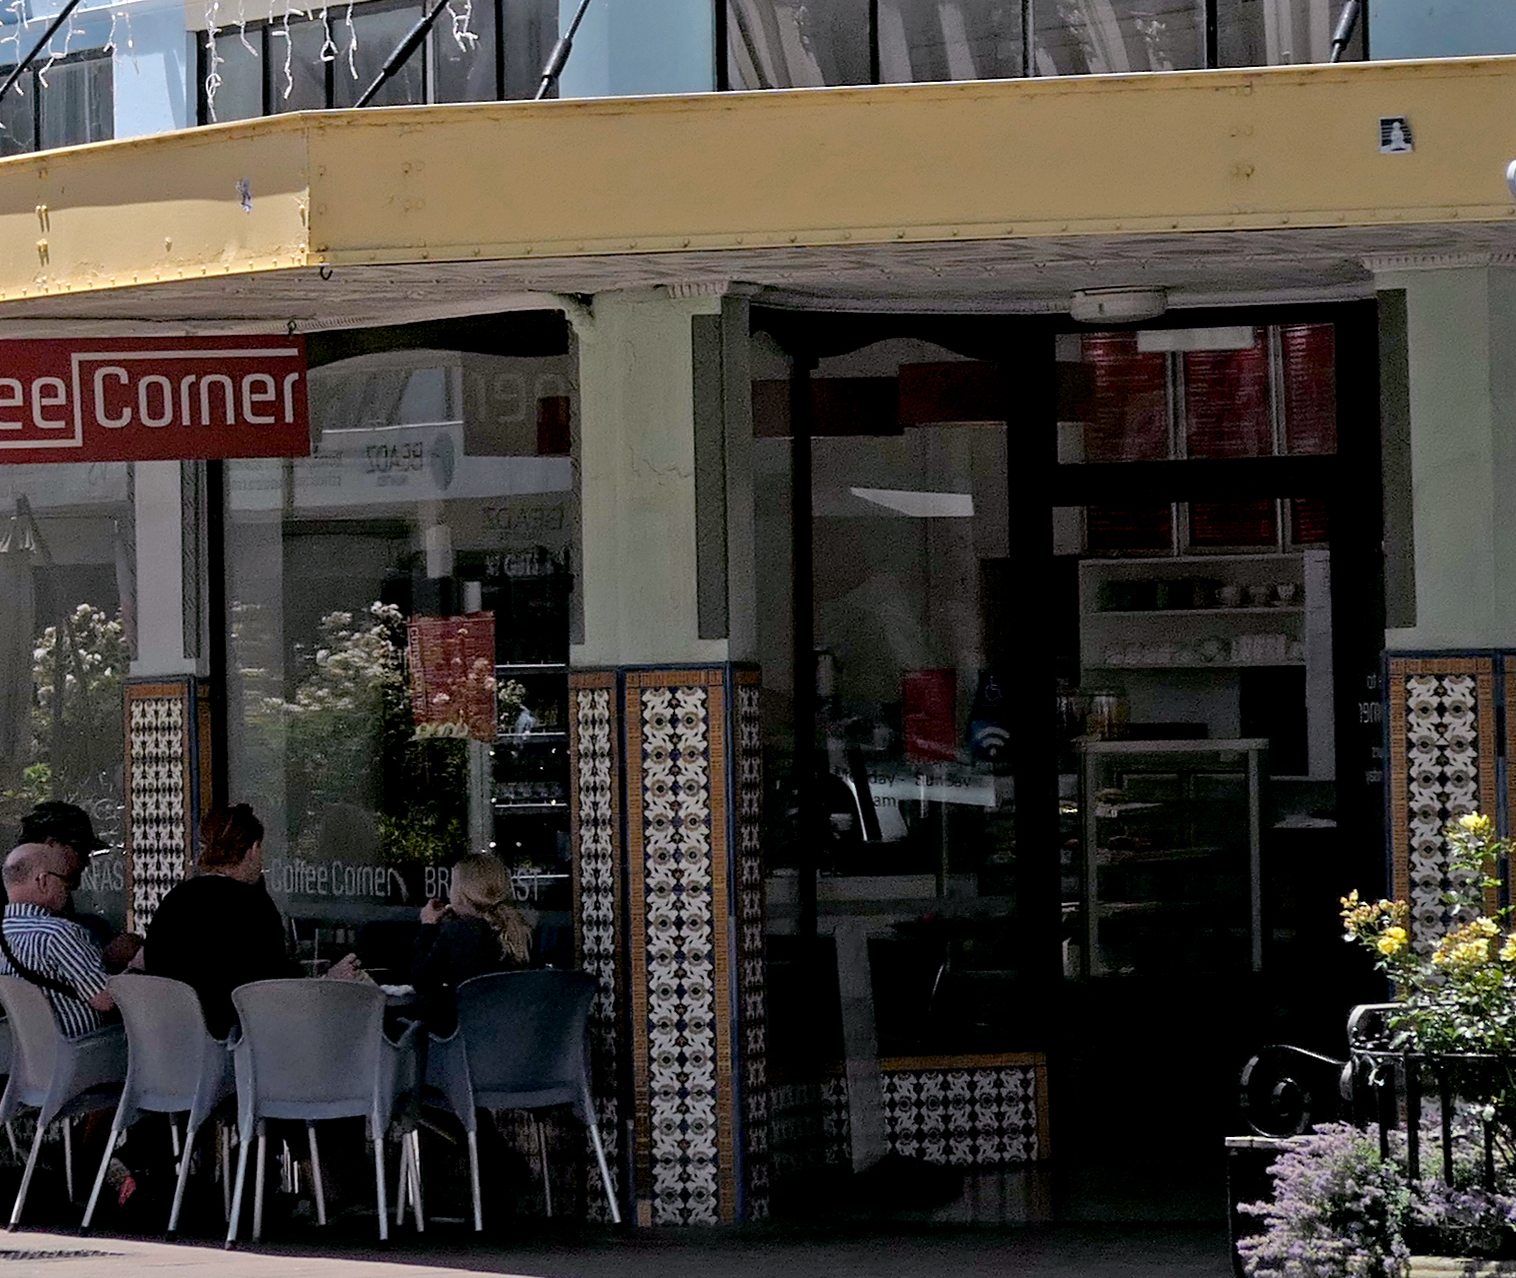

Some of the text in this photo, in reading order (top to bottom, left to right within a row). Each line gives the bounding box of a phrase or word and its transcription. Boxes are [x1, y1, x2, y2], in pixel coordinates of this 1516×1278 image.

[94, 366, 300, 429] Corner
[270, 859, 394, 897] Coffee Corner
